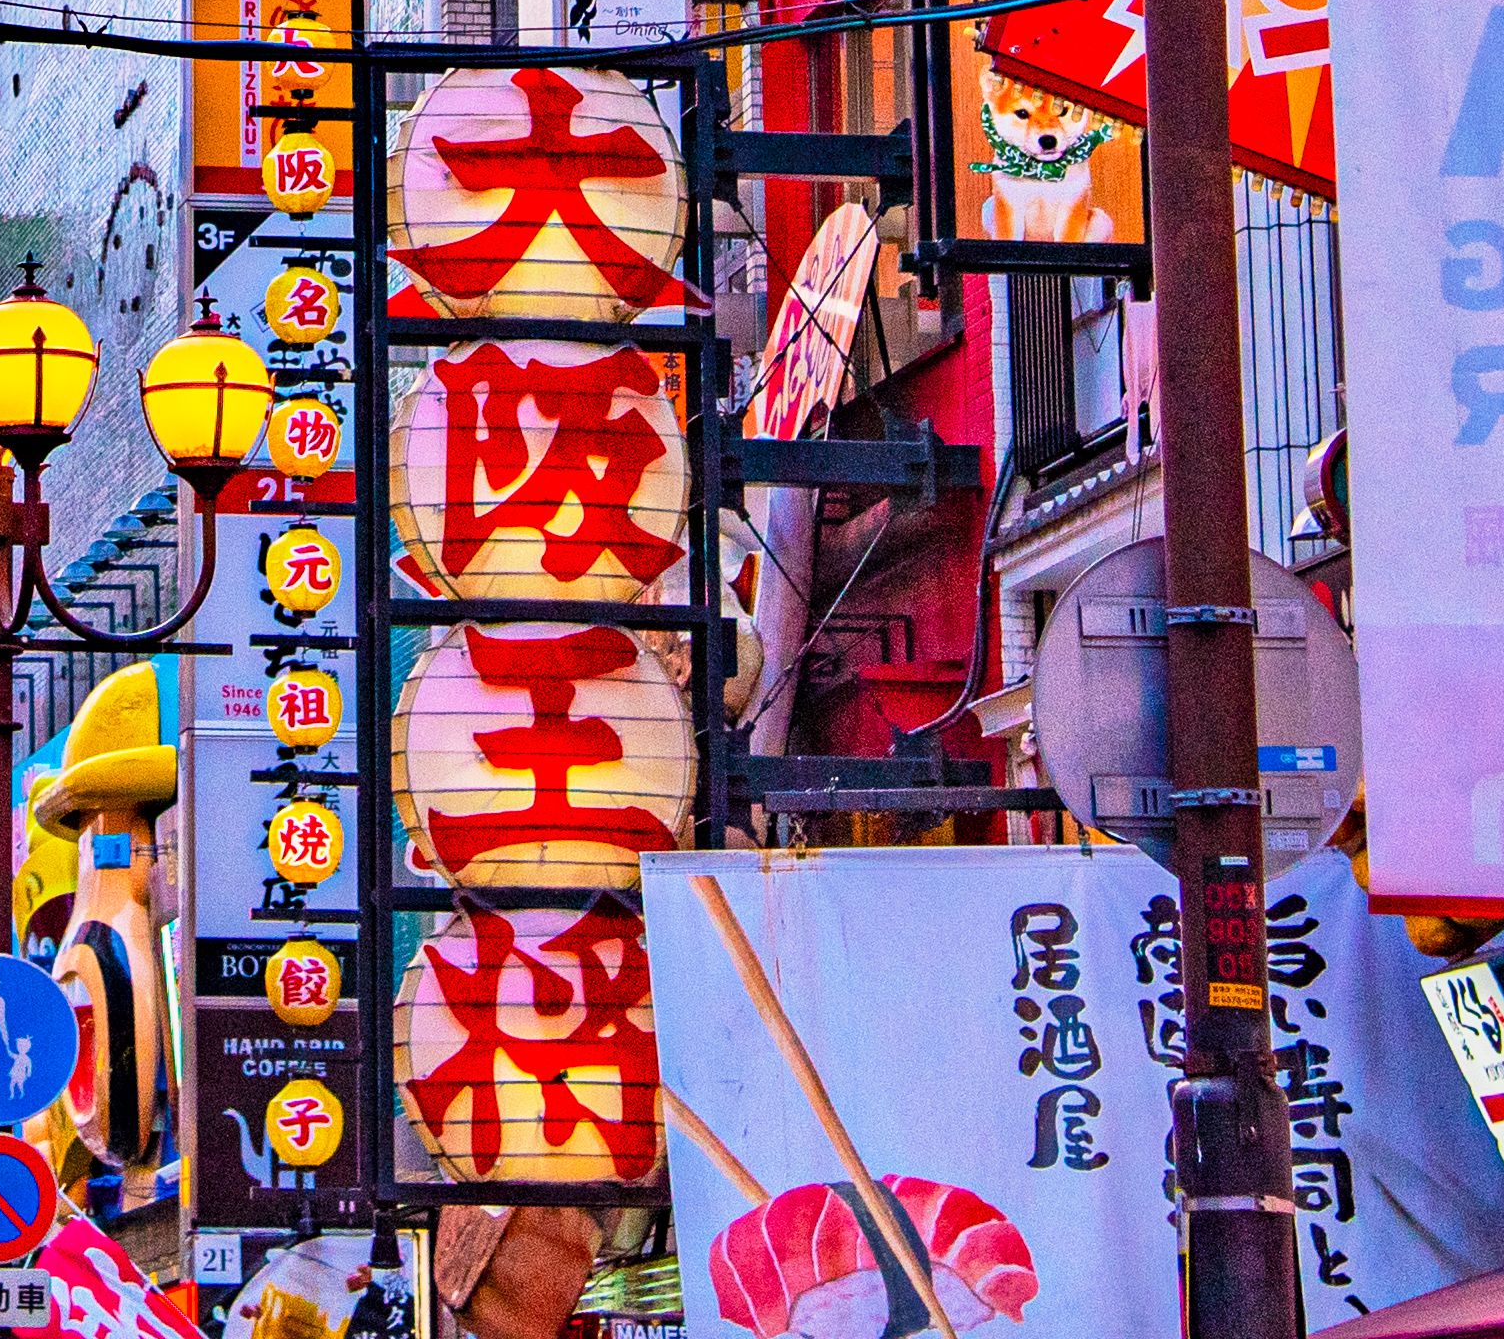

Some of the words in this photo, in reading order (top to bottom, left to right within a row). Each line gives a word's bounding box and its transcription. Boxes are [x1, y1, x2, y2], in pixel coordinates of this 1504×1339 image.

[615, 20, 668, 42] Dining
[198, 222, 235, 251] 3F
[222, 684, 263, 699] Since
[224, 704, 262, 716] 1946
[1010, 903, 1109, 1171] 居酒屋
[202, 1249, 235, 1272] 2F
